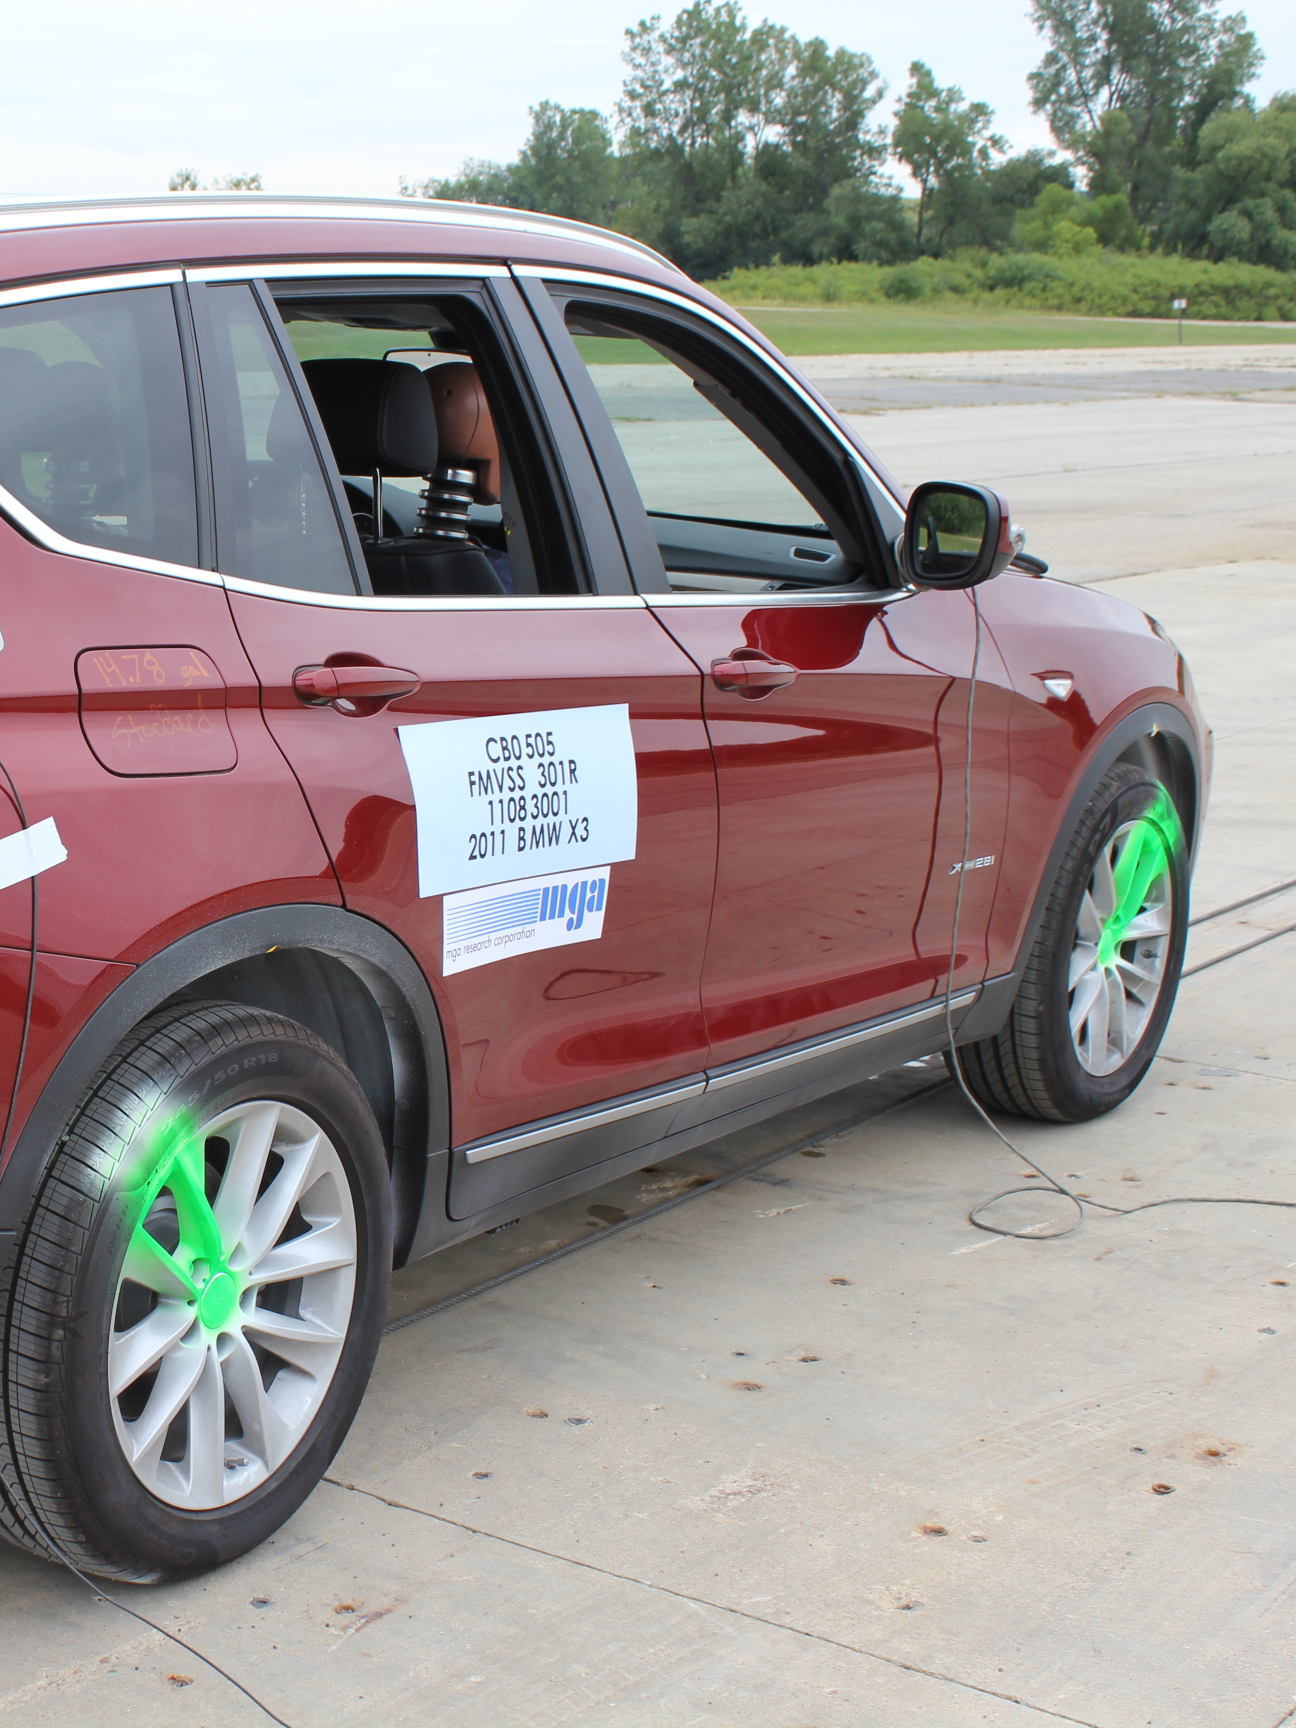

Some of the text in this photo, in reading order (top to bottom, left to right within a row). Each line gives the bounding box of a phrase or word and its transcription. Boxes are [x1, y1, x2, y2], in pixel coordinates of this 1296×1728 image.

[467, 759, 579, 798] FMVSS 301R
[468, 816, 590, 861] 2011 BMW X3
[538, 878, 606, 932] mga
[445, 926, 536, 962] mga research corporation
